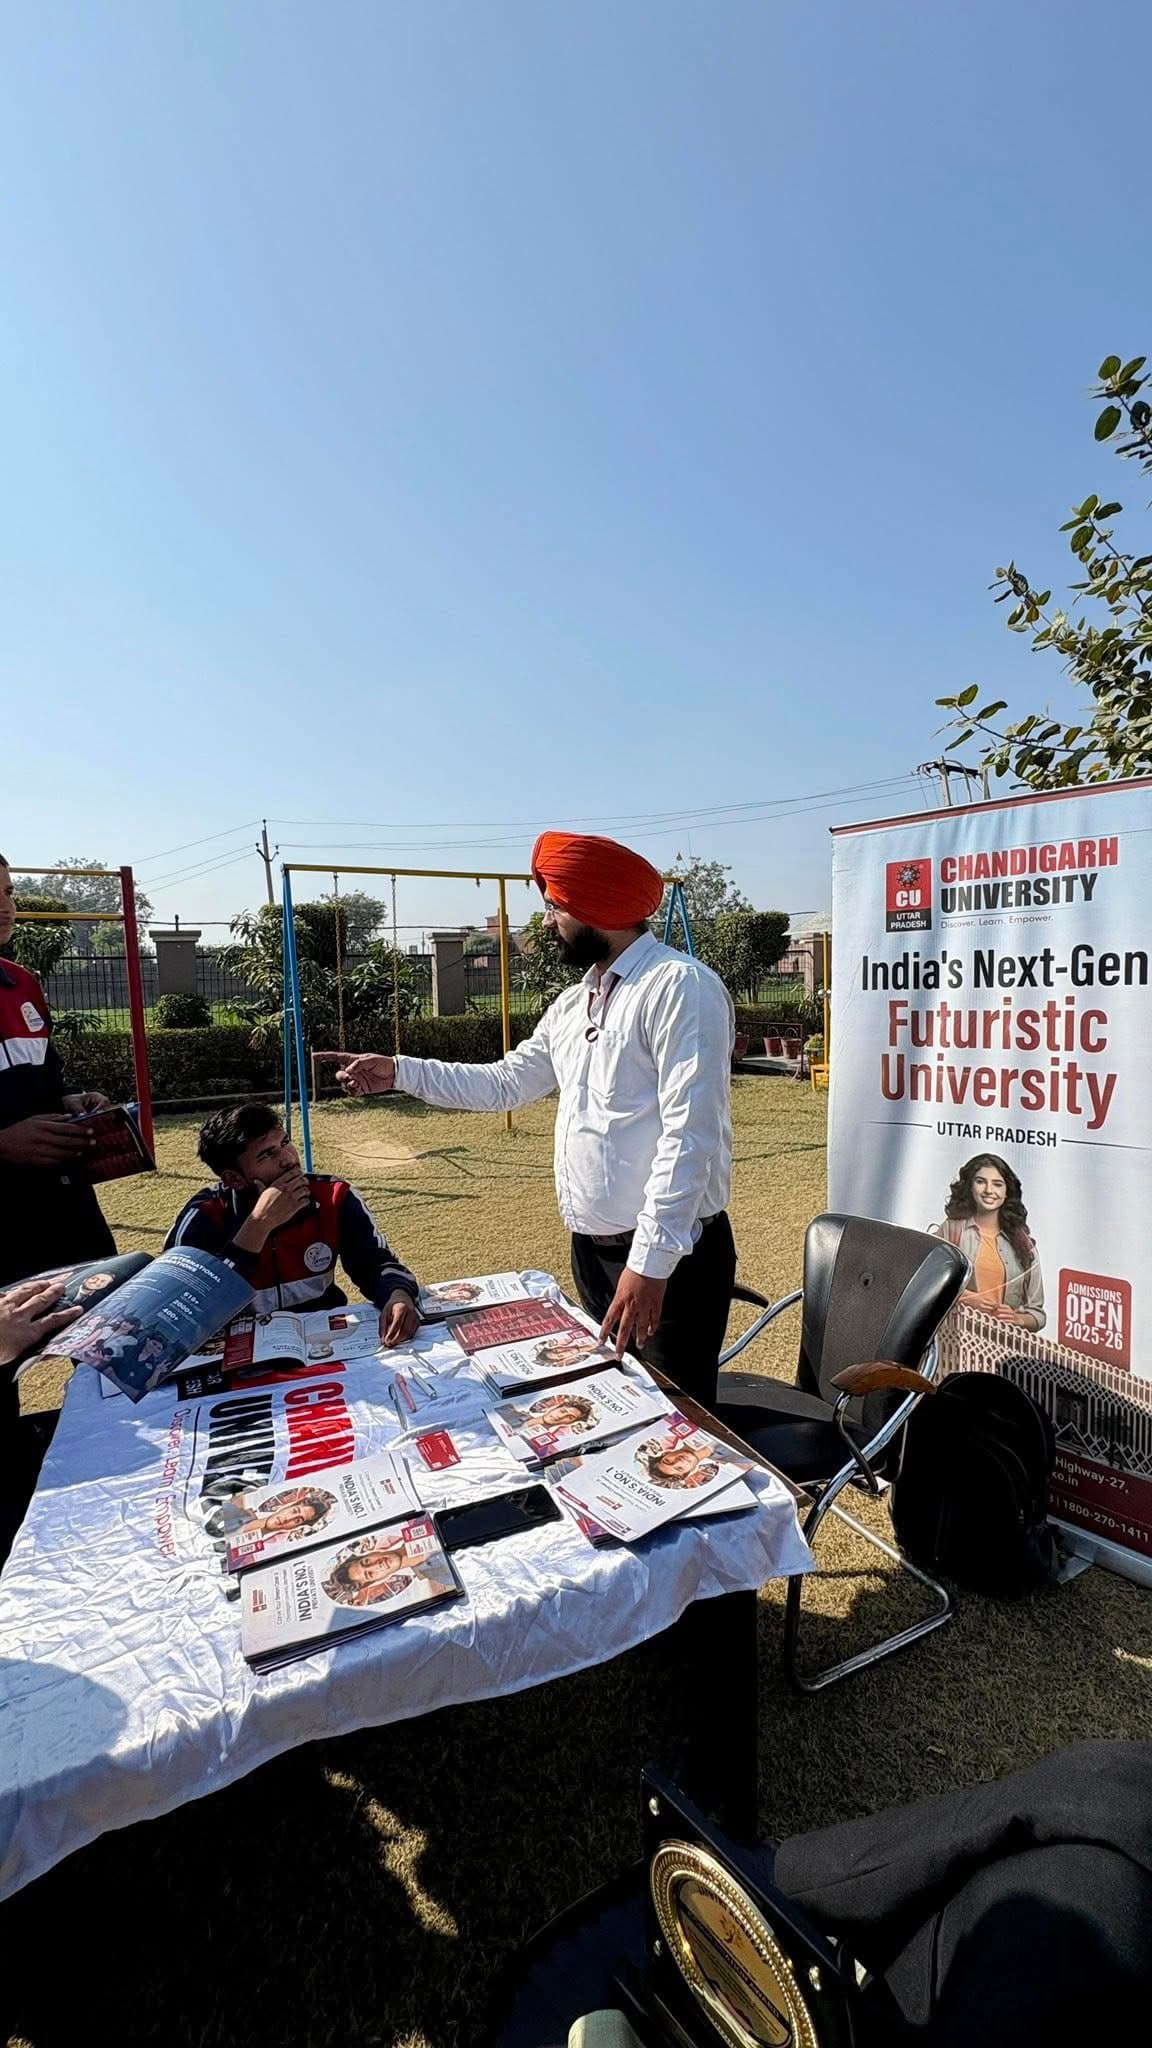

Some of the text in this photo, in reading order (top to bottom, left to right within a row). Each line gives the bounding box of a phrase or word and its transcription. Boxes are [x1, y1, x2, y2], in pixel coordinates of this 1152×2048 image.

[940, 837, 1118, 884] CHANDIGARH
[896, 889, 921, 907] CU
[940, 873, 1098, 914] UNIVERSITY
[890, 920, 927, 929] PRADESH
[896, 911, 921, 921] UTTAR
[940, 920, 976, 929] Discover.
[1008, 914, 1055, 926] Empower.
[862, 944, 1149, 990] India's Next-Gen
[888, 996, 1108, 1053] Futuristic
[881, 1053, 1118, 1130] University
[937, 1121, 1057, 1147] UTTAR PRADESH
[1067, 1281, 1122, 1303] ADMISSIONS
[1065, 1293, 1123, 1333] OPEN
[1064, 1320, 1123, 1350] 2025-26
[342, 1474, 360, 1503] INDIA'S
[628, 1482, 666, 1506] INDIA'S
[1063, 1499, 1150, 1542] 1800-270-1411
[296, 1580, 313, 1622] INDIA'S
